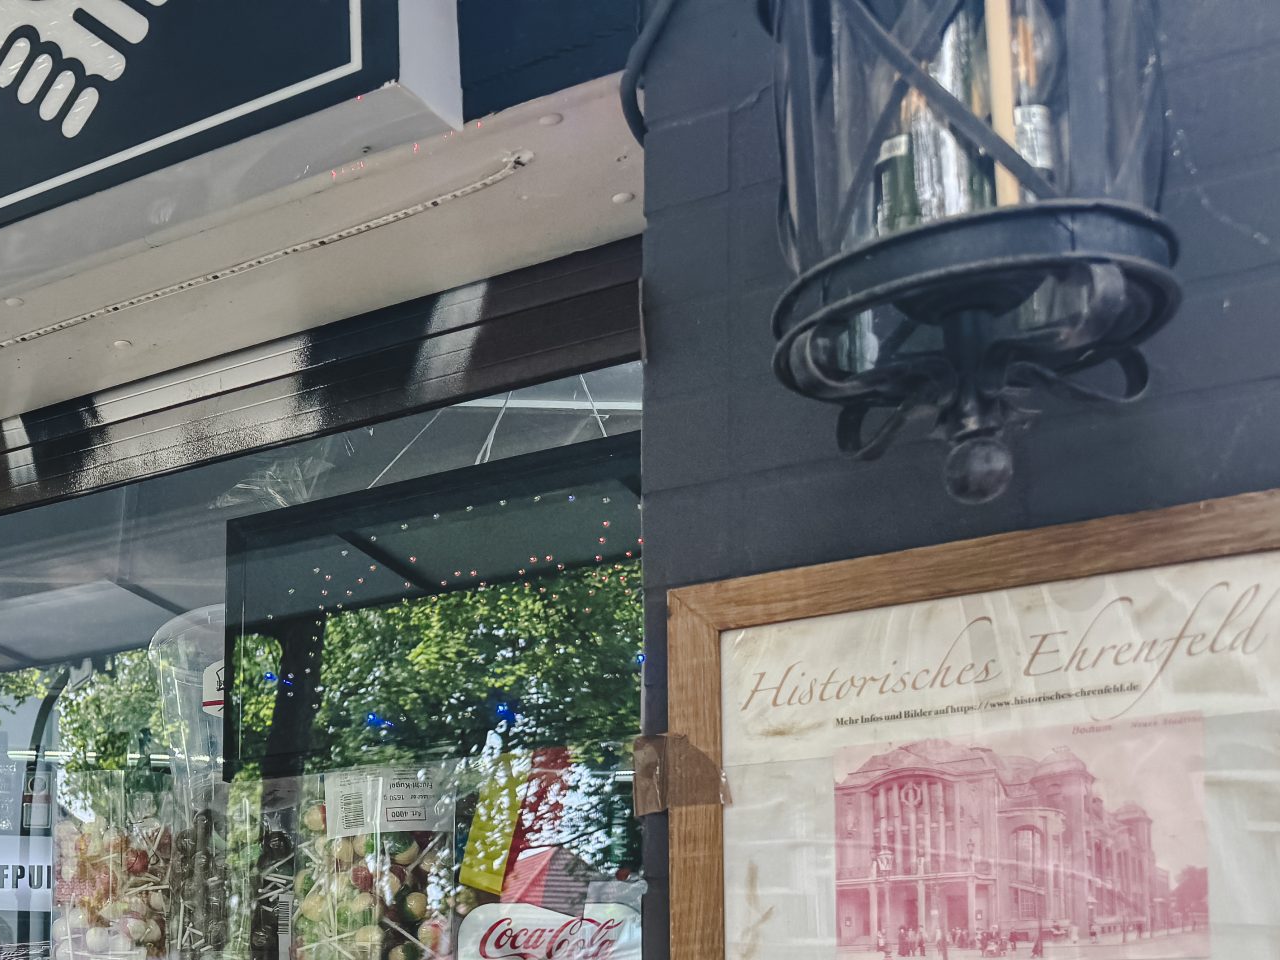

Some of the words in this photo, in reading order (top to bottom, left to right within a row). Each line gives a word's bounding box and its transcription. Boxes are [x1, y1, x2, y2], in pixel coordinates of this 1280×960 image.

[741, 616, 1001, 711] Historisches
[1023, 581, 1280, 721] Ehrenfeld
[835, 716, 859, 727] Mehr
[860, 713, 883, 725] Infos
[884, 711, 903, 722] und
[904, 709, 932, 719] Bilder
[479, 917, 623, 960] Coca-Cola
